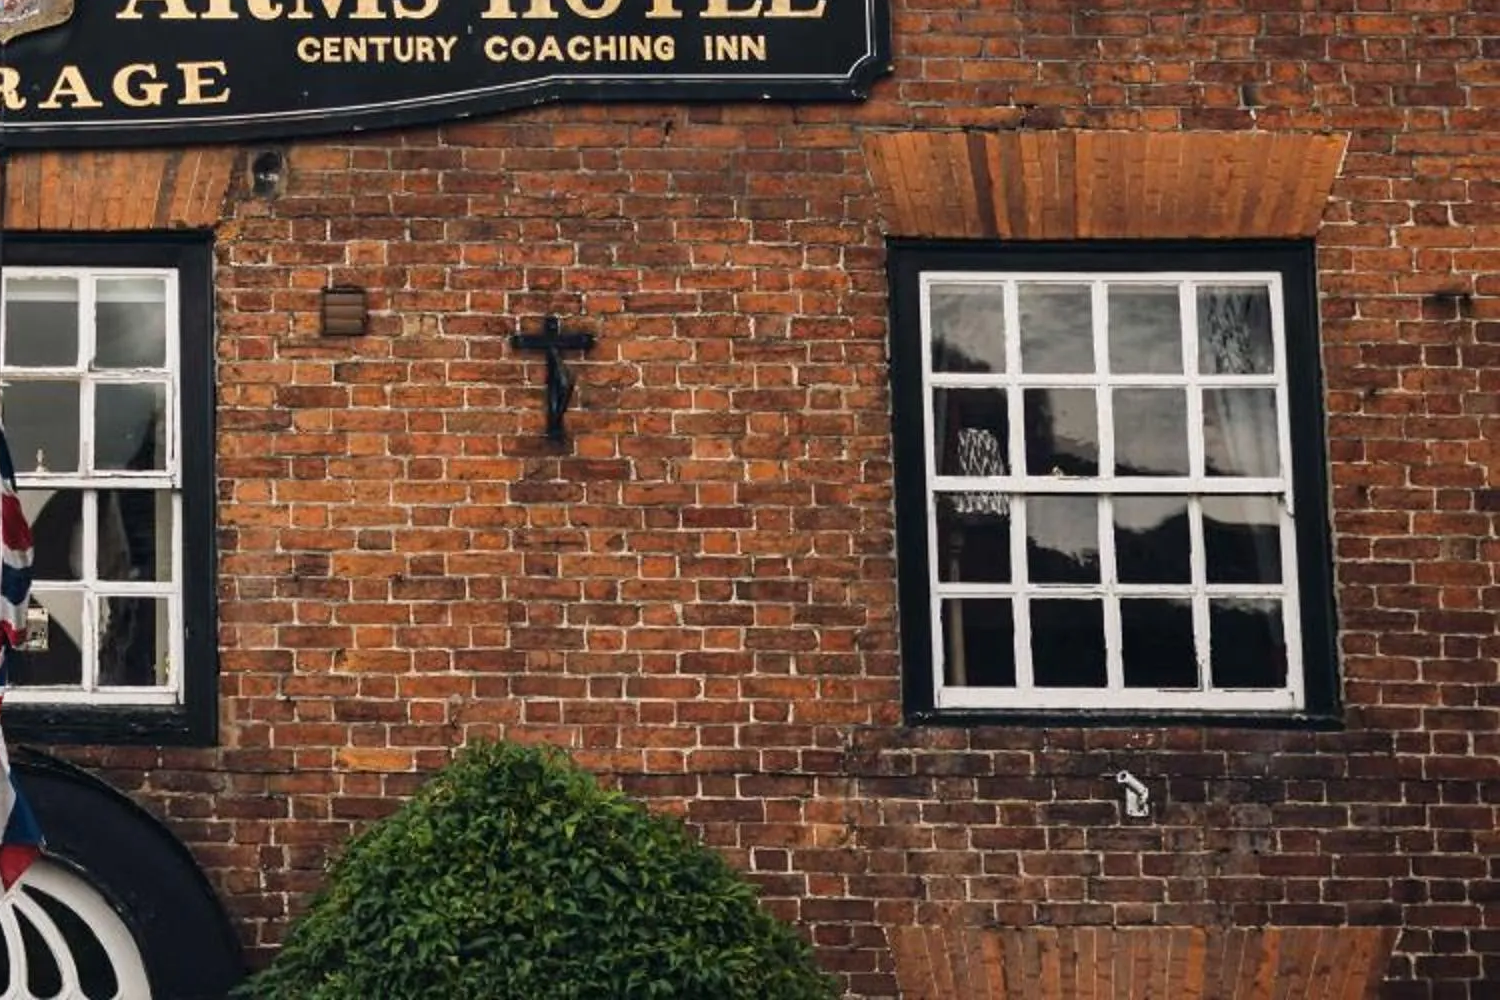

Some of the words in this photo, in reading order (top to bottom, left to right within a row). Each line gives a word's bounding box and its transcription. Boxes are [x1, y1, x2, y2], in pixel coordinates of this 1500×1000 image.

[297, 36, 457, 62] CENTURY
[484, 36, 675, 61] COACHING
[704, 36, 767, 60] INN
